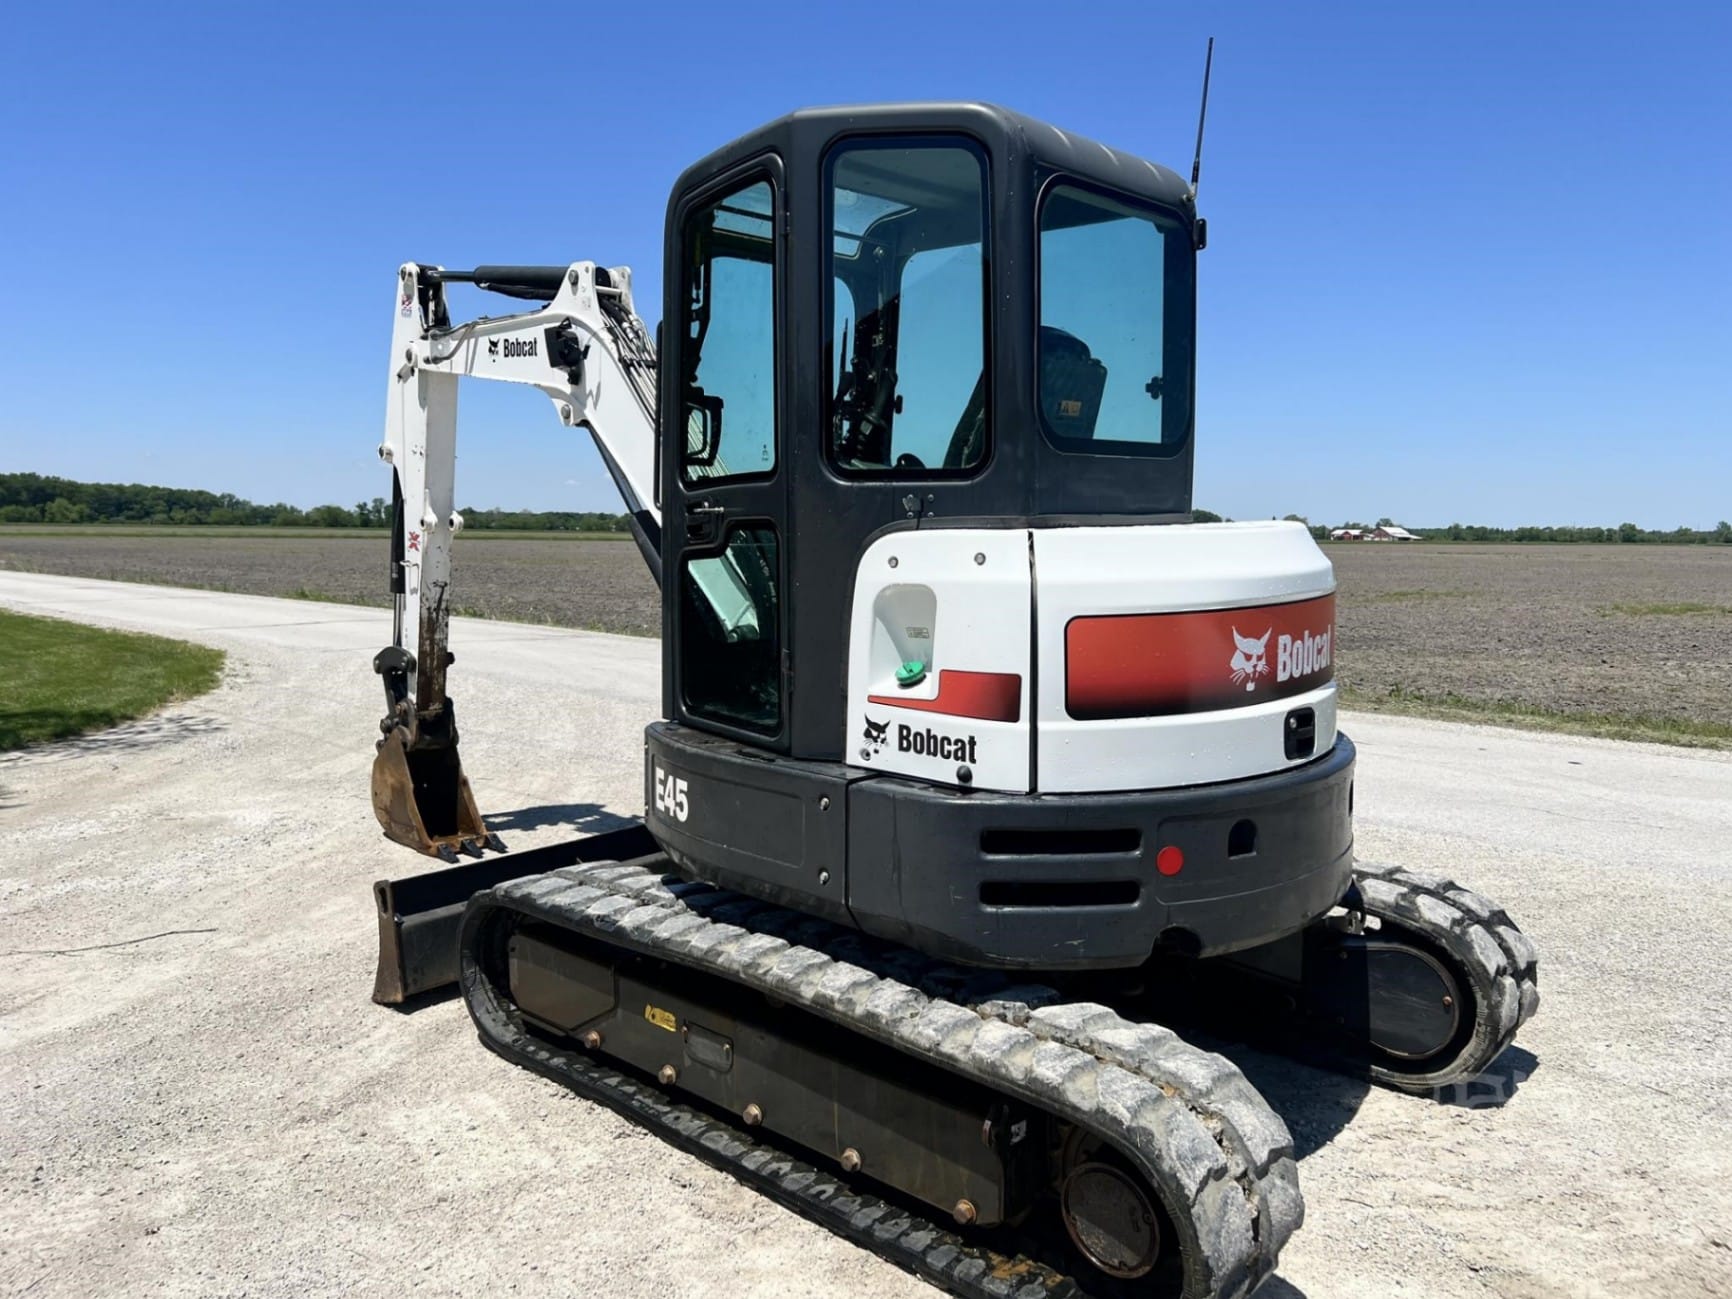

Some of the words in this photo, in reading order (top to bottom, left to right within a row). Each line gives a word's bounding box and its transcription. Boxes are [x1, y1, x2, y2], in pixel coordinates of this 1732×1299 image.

[503, 336, 538, 358] Bobcat
[898, 723, 977, 764] Bobcat
[655, 766, 689, 822] E45
